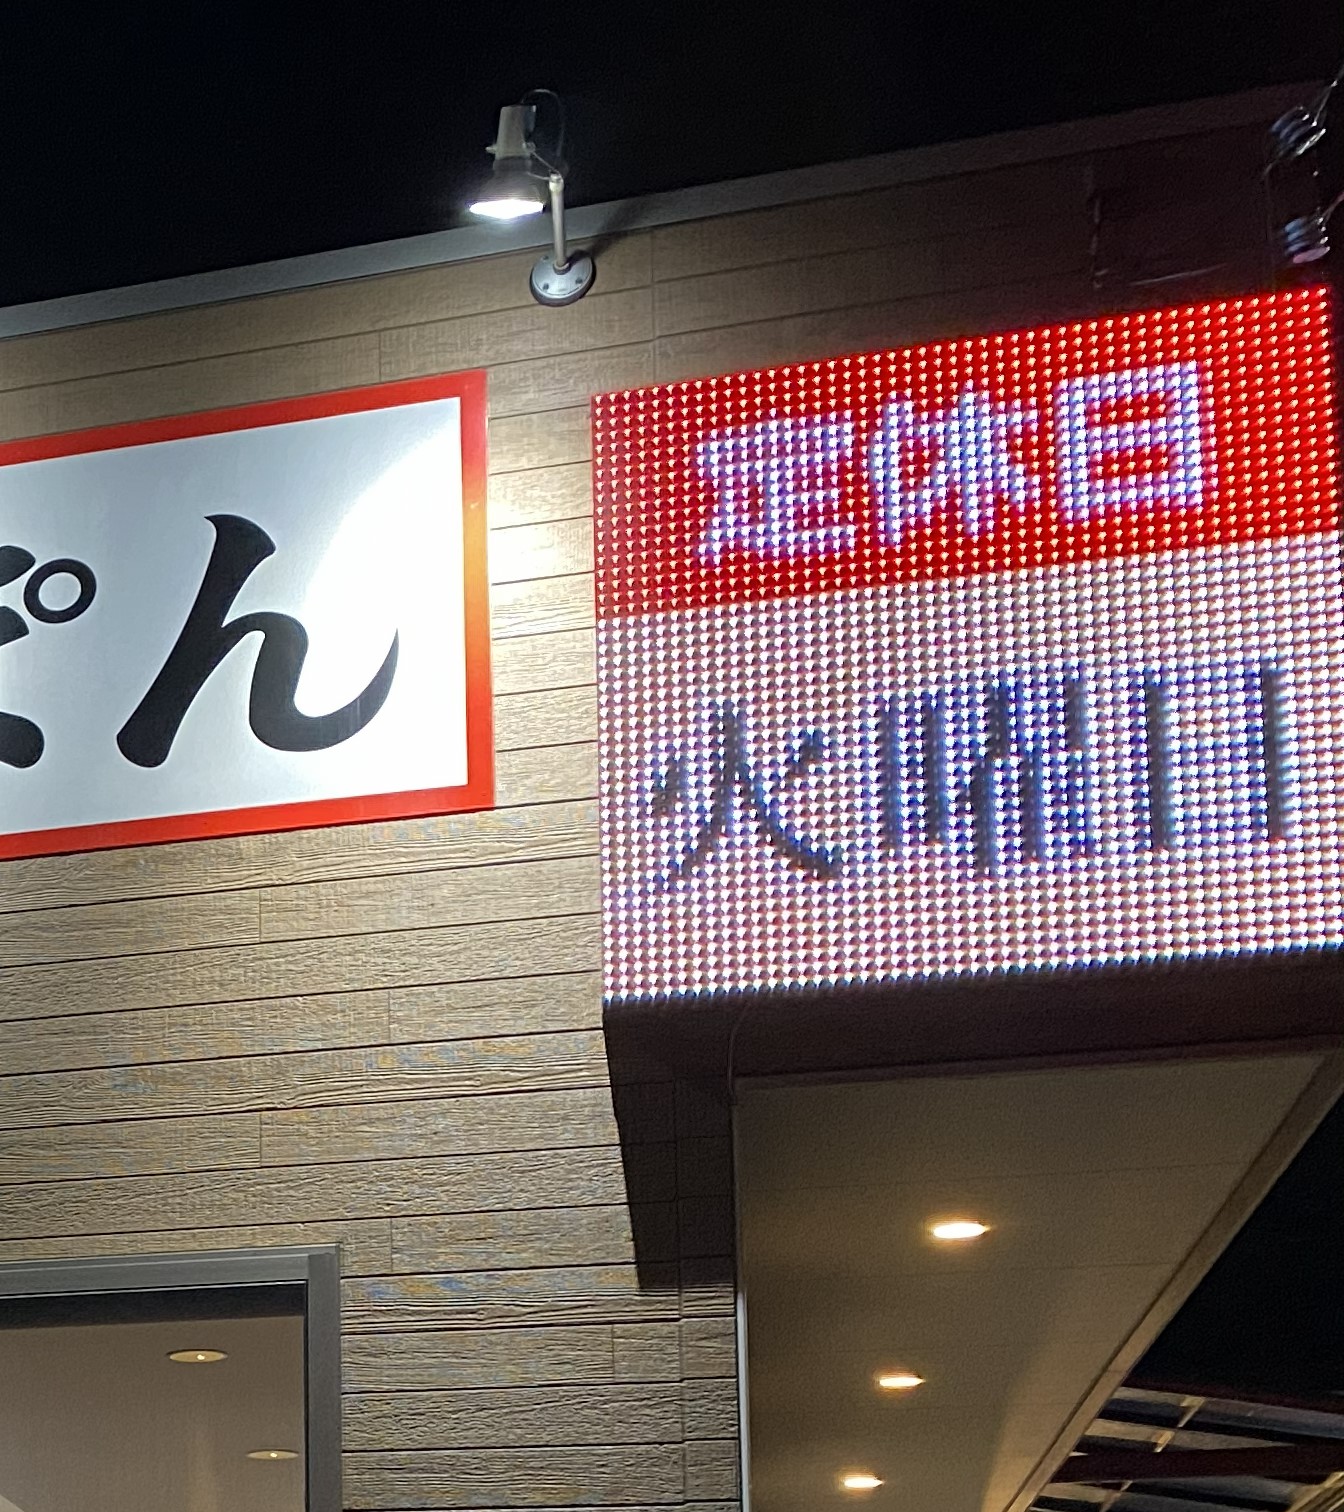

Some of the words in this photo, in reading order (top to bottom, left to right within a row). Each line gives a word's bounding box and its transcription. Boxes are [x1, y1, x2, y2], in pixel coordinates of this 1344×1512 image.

[693, 361, 1208, 566] 定休日
[644, 655, 1288, 892] 火曜日
